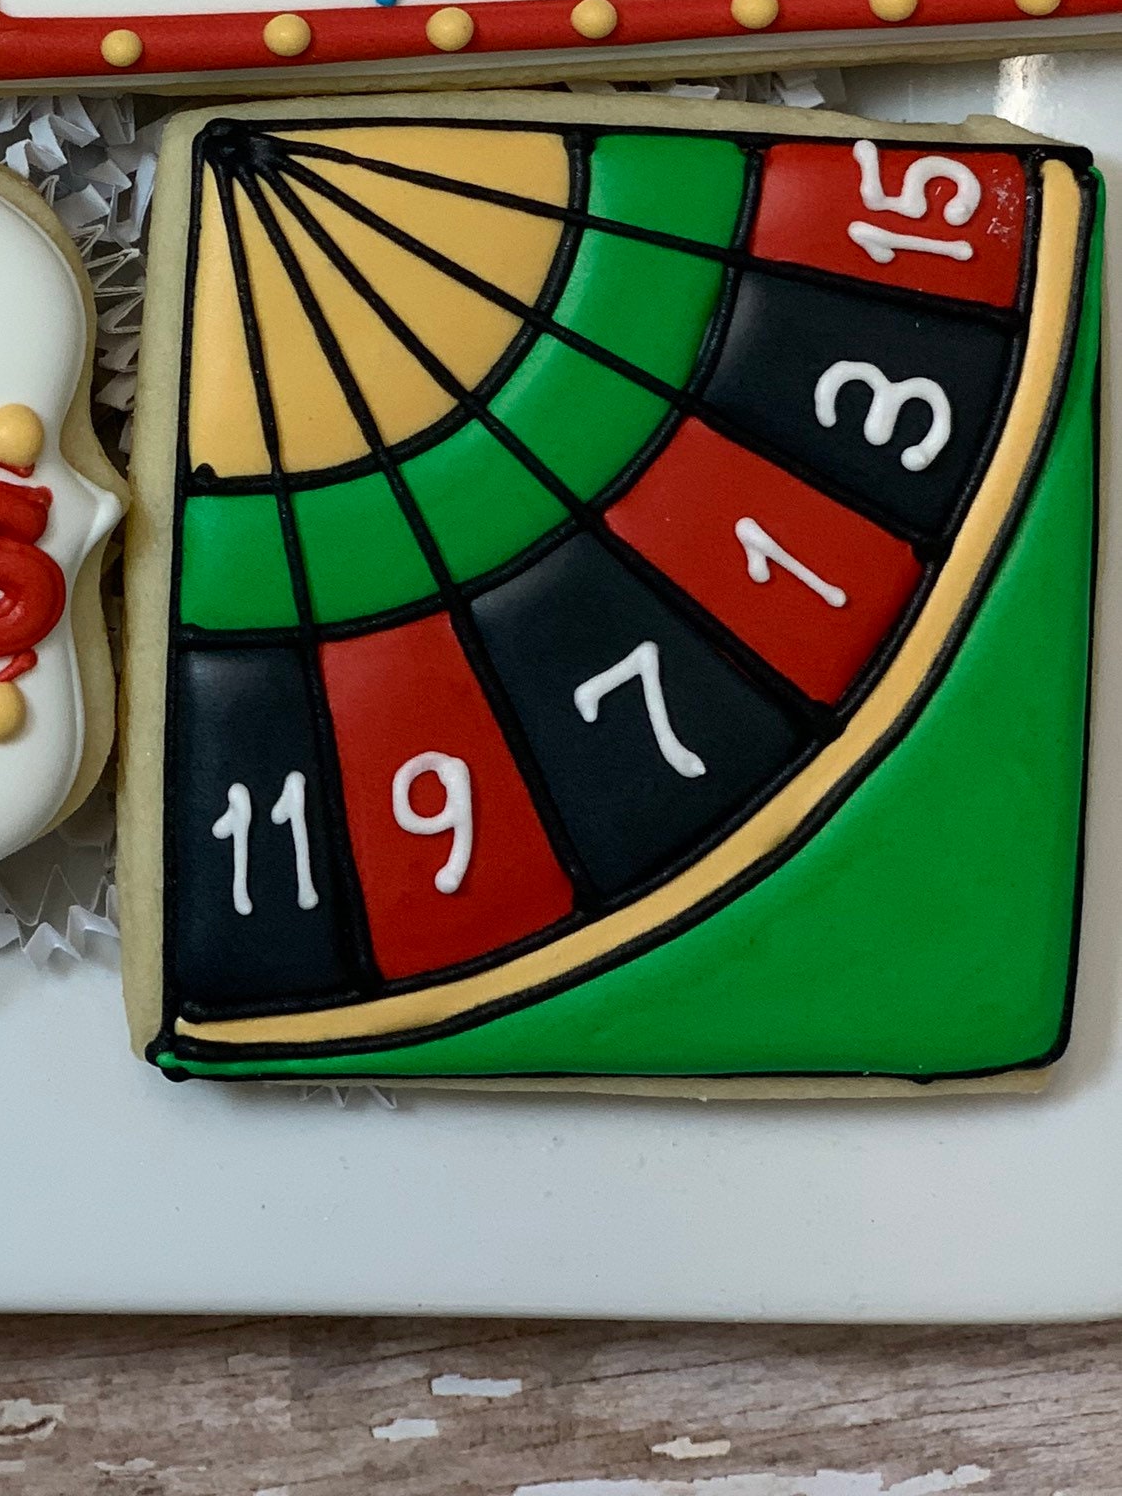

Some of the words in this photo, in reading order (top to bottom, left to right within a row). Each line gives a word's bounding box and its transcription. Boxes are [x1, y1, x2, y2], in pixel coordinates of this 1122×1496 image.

[846, 138, 981, 265] 15
[813, 359, 953, 472] 3
[733, 516, 848, 608] 1
[572, 639, 707, 779] 7
[210, 769, 320, 916] 11
[390, 750, 474, 895] 9
